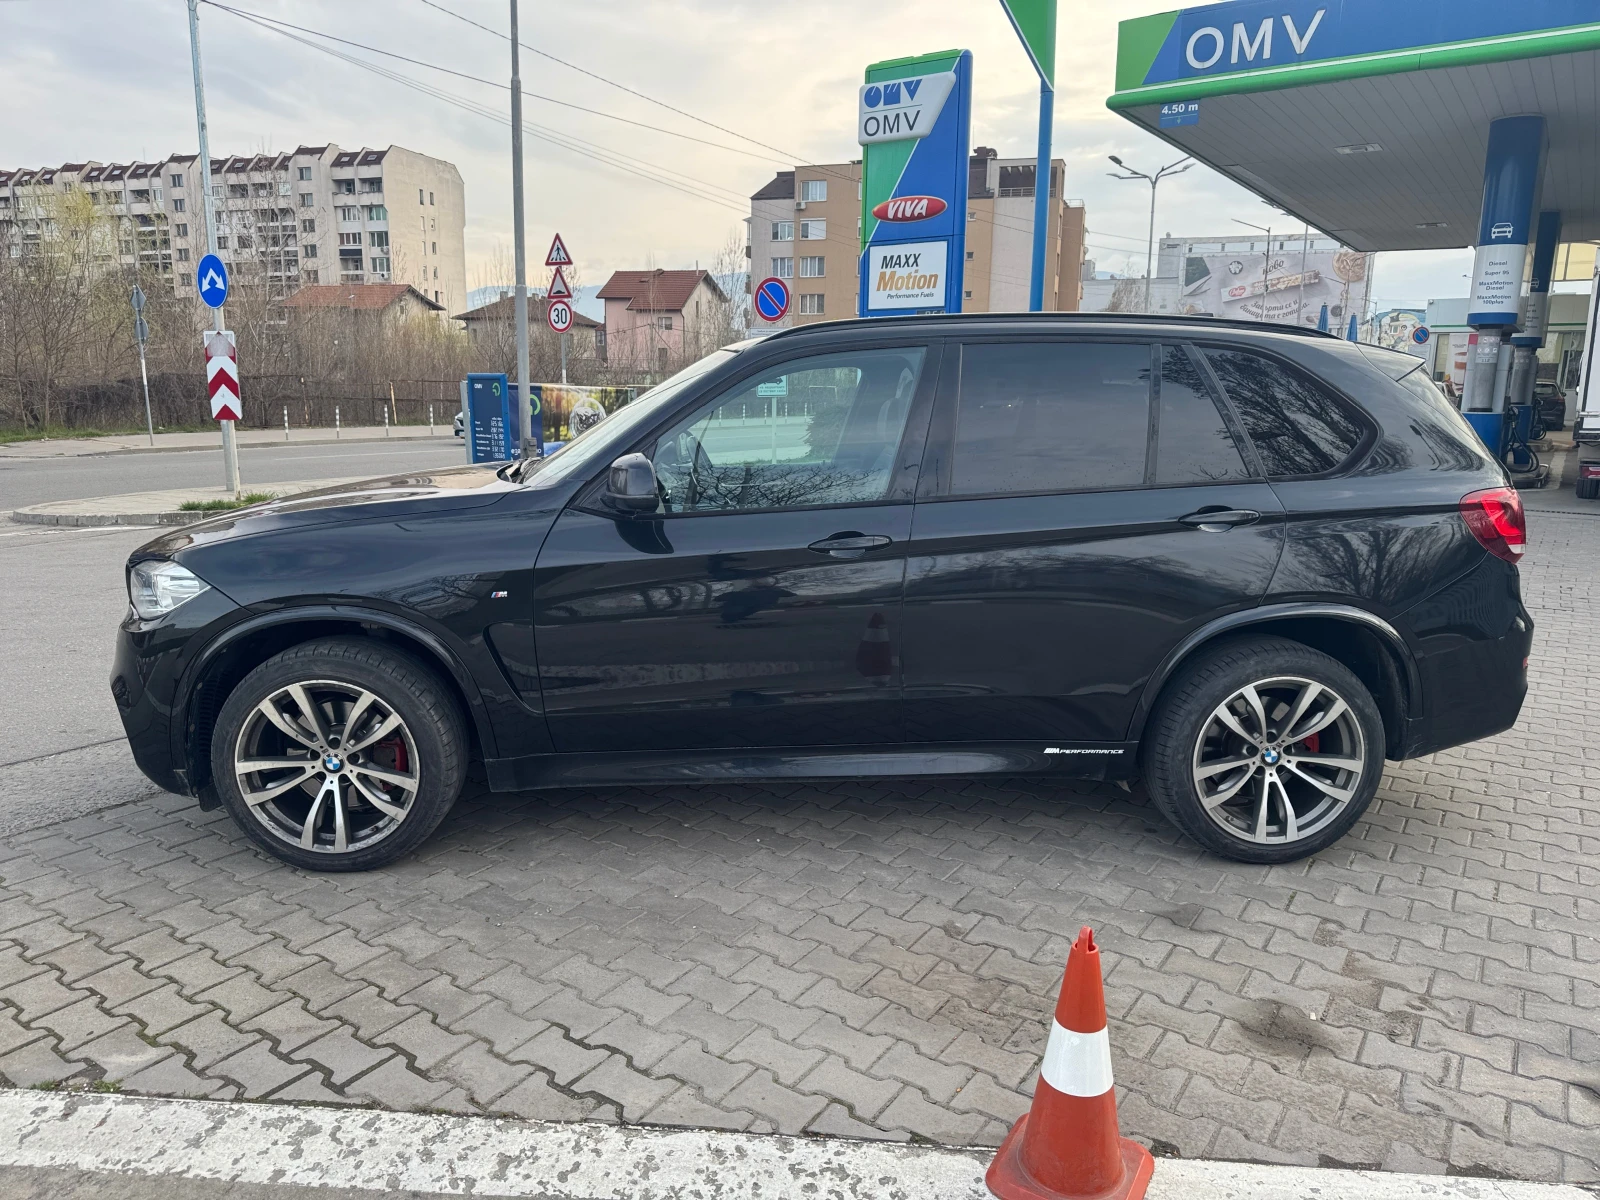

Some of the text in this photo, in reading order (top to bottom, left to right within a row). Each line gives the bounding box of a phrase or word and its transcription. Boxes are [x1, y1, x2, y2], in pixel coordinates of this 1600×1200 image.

[1186, 8, 1326, 70] OMV
[1161, 103, 1199, 114] 4.50 m
[864, 109, 921, 137] OMV
[887, 199, 929, 220] VIVA
[881, 253, 921, 269] MAXX
[876, 269, 939, 292] Motion
[553, 308, 567, 324] 30
